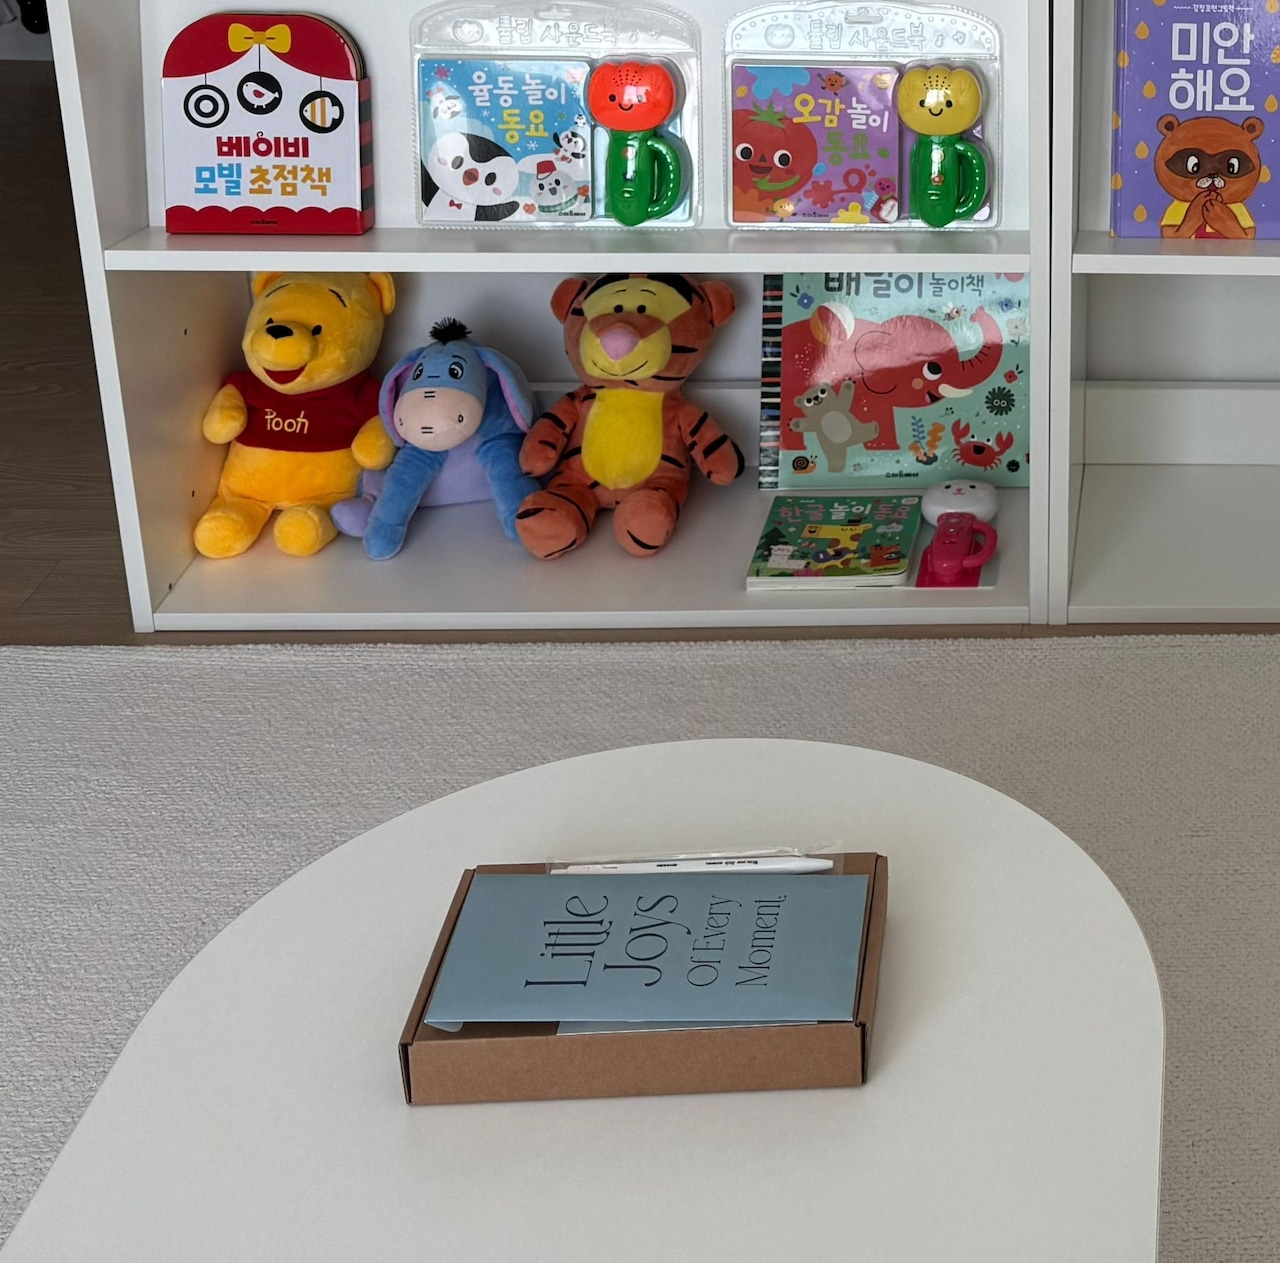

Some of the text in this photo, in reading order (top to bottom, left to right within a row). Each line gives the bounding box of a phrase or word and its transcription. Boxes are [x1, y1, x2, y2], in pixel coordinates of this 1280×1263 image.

[1171, 22, 1255, 65] 미안
[1169, 67, 1255, 112] 해요
[498, 108, 549, 144] 동요
[792, 93, 889, 133] 오감 놀이
[216, 131, 310, 158] 베이비
[822, 131, 871, 166] 동요
[194, 163, 332, 197] 모빌 초점책
[929, 272, 985, 297] 놀이책
[264, 408, 309, 434] Pooh
[779, 502, 911, 523] 한글 놀이 동요
[603, 895, 692, 987] Joys
[692, 895, 743, 952] Every
[524, 895, 613, 988] Little
[686, 956, 722, 987] Of
